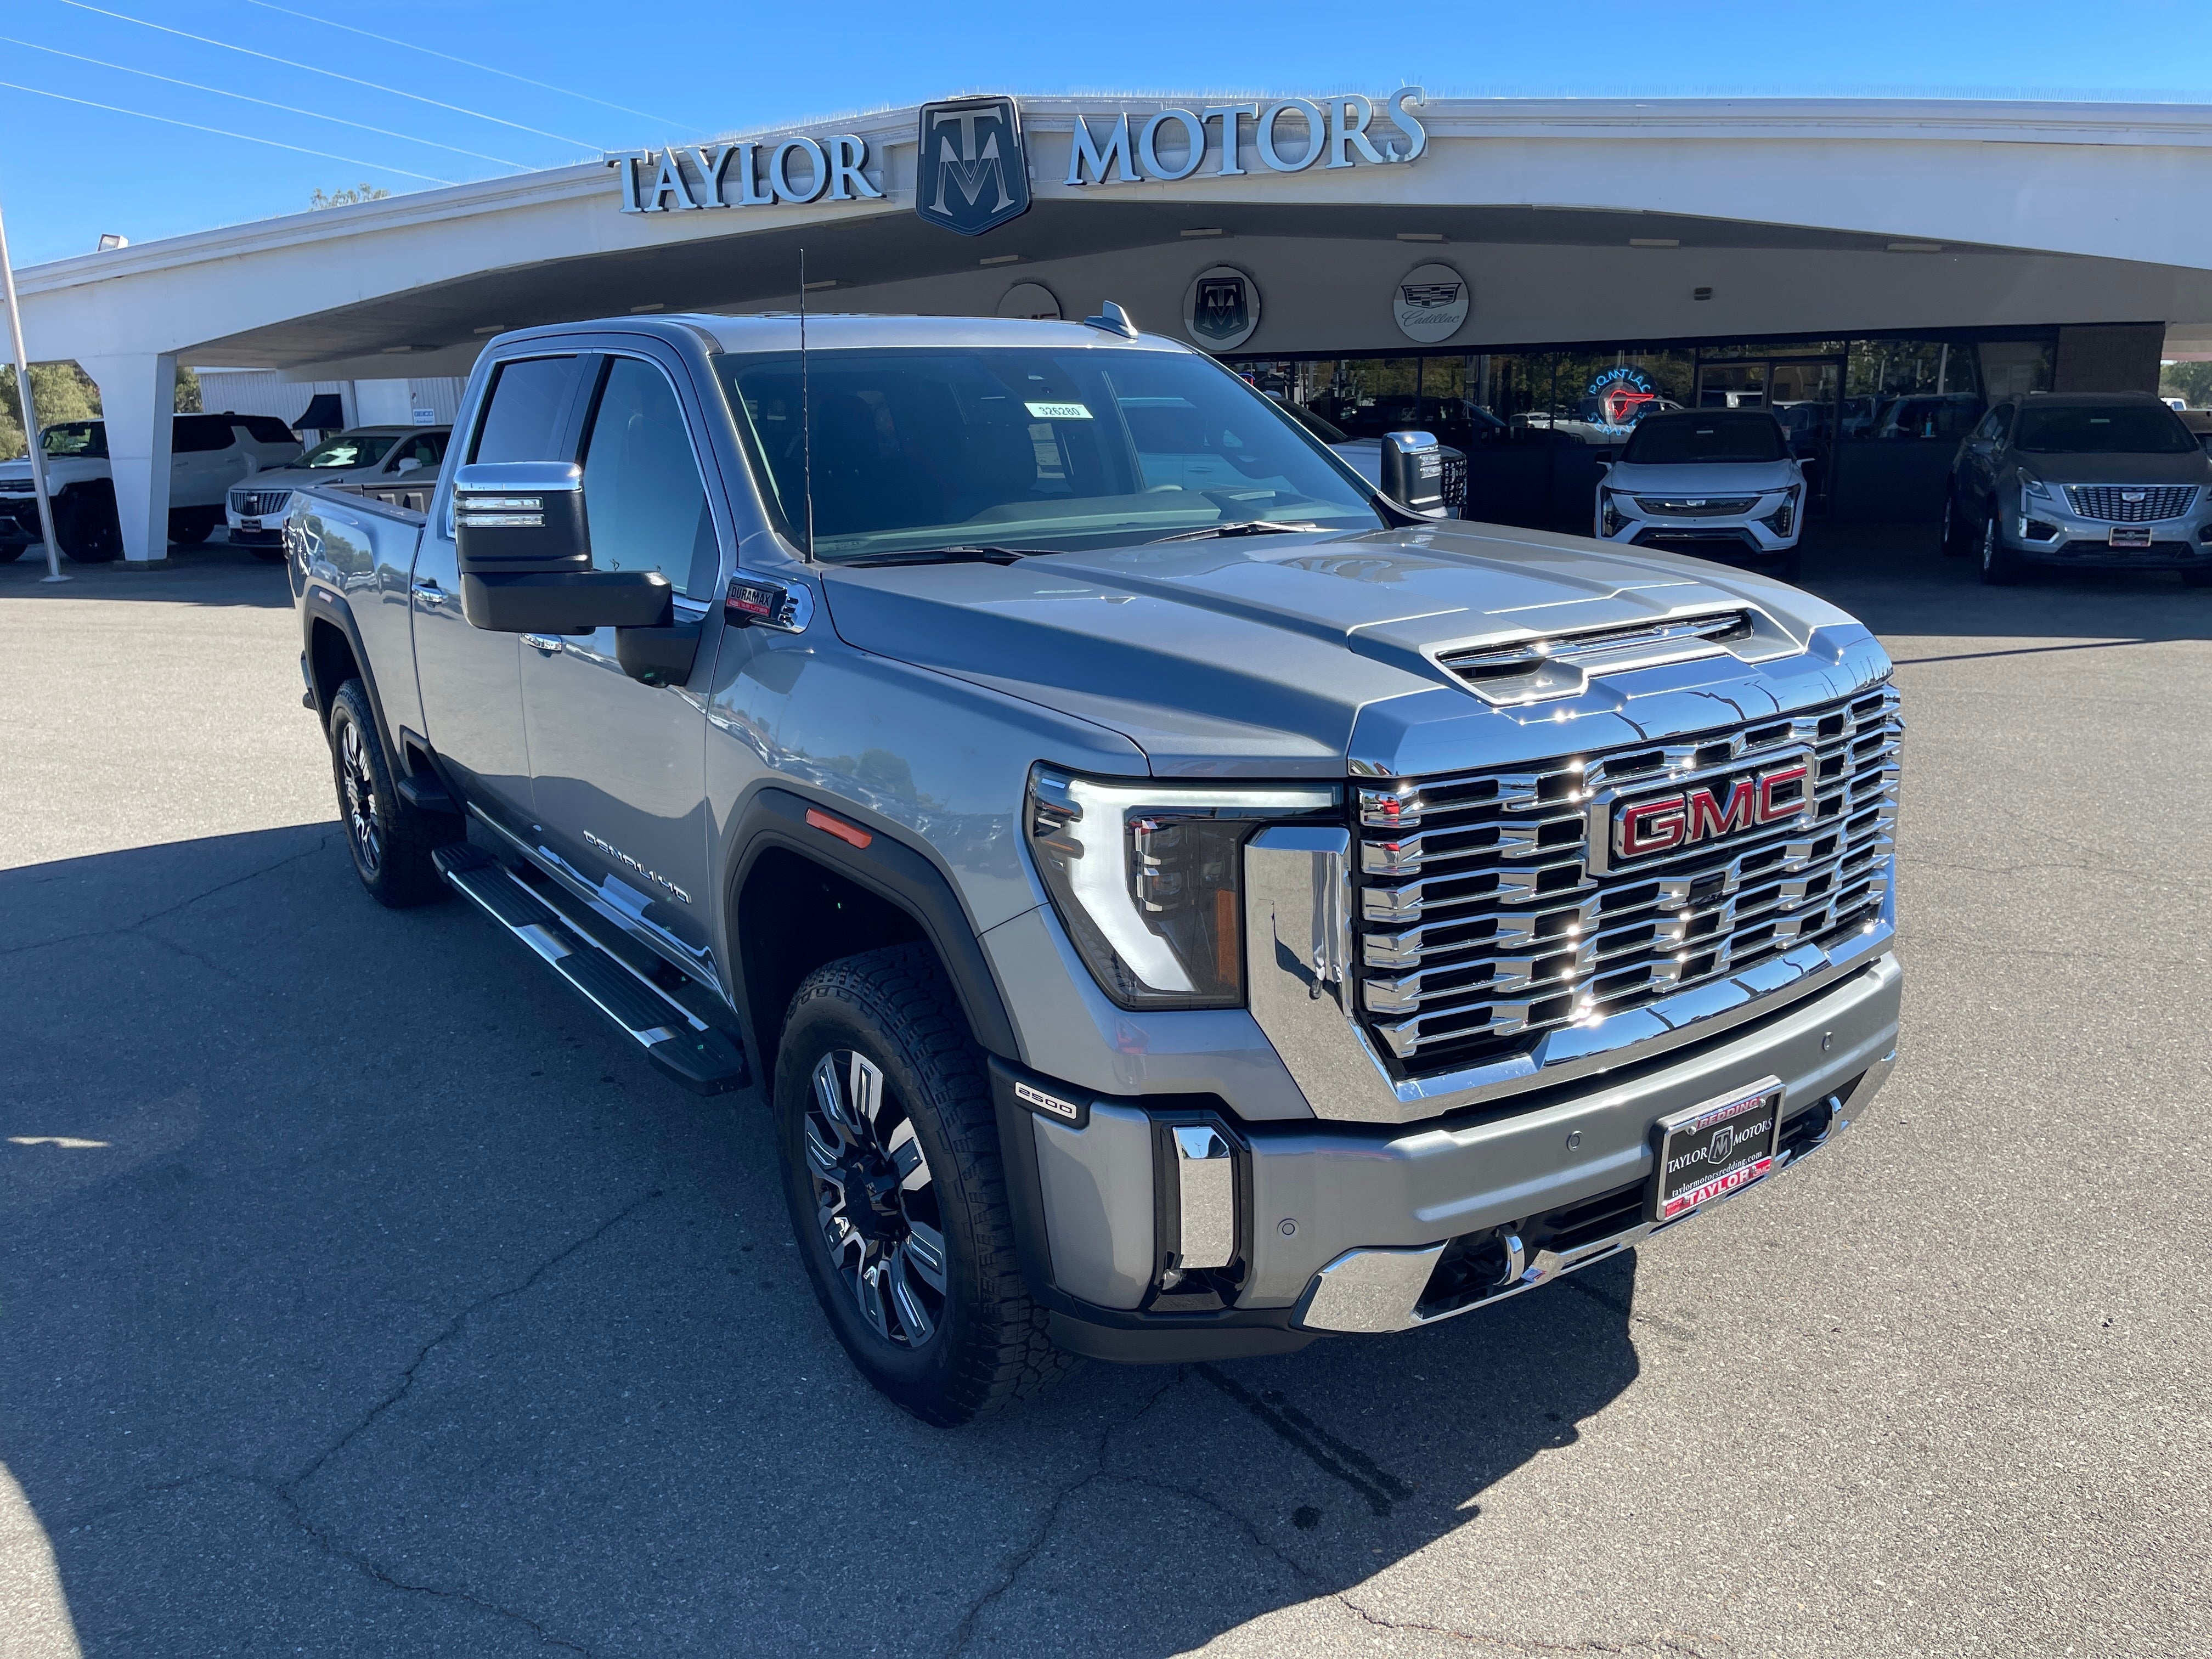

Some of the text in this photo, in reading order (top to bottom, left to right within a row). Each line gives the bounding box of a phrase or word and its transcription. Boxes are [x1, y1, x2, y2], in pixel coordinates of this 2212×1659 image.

[603, 86, 1426, 214] TAYLOR MOTORS
[1402, 310, 1460, 327] Cadillac
[1589, 368, 1651, 394] PONTIAC
[1039, 407, 1080, 416] 326280
[731, 586, 770, 606] DURAMAX
[1613, 762, 1807, 859] GMC
[583, 830, 693, 905] DENALI HD
[1019, 1087, 1073, 1114] 2500
[1699, 1098, 1759, 1128] REDDING
[1667, 1117, 1773, 1173] TAYLOR MOTORS
[1672, 1150, 1763, 1198] taylormotorsredding.com
[1689, 1169, 1751, 1206] TAYLOR
